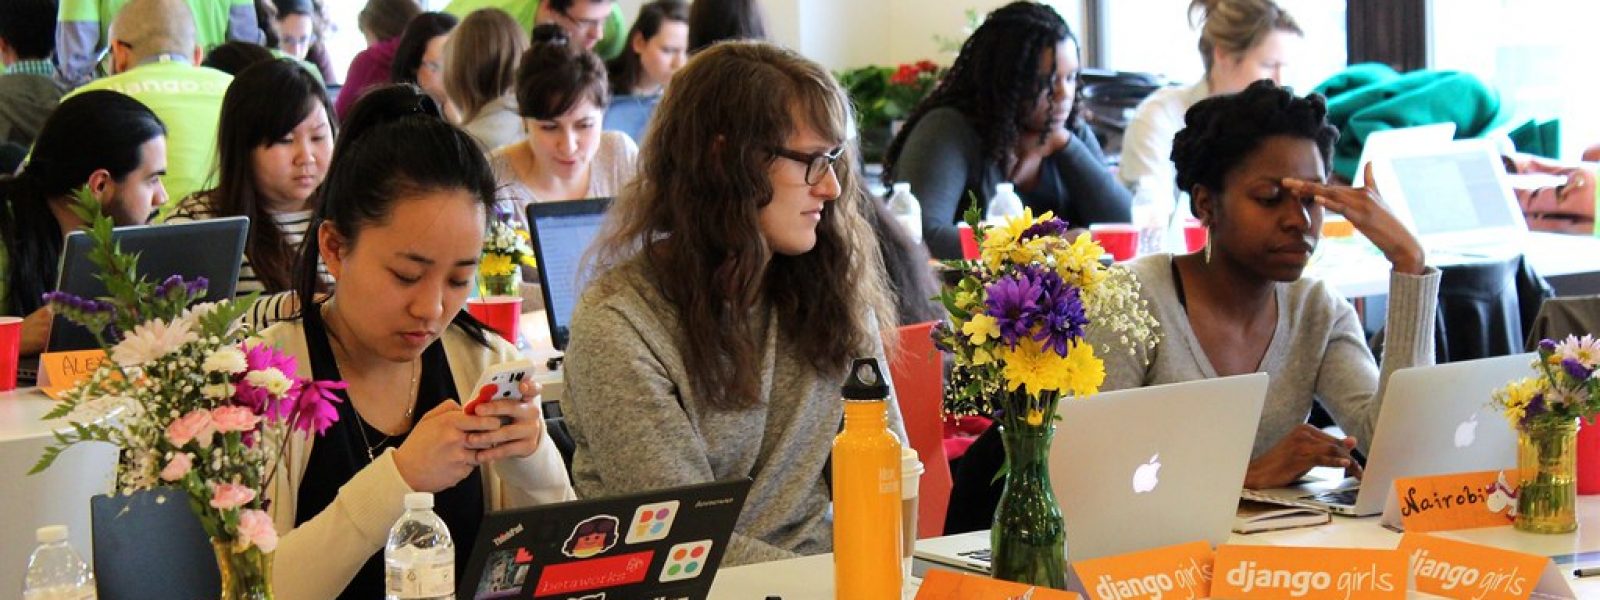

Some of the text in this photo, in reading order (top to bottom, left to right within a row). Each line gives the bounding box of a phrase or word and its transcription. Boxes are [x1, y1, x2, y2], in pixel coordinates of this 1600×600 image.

[1401, 486, 1485, 516] Nairobi
[1096, 556, 1214, 600] django girls
[1226, 560, 1395, 600] django girls
[1471, 566, 1526, 600] girls
